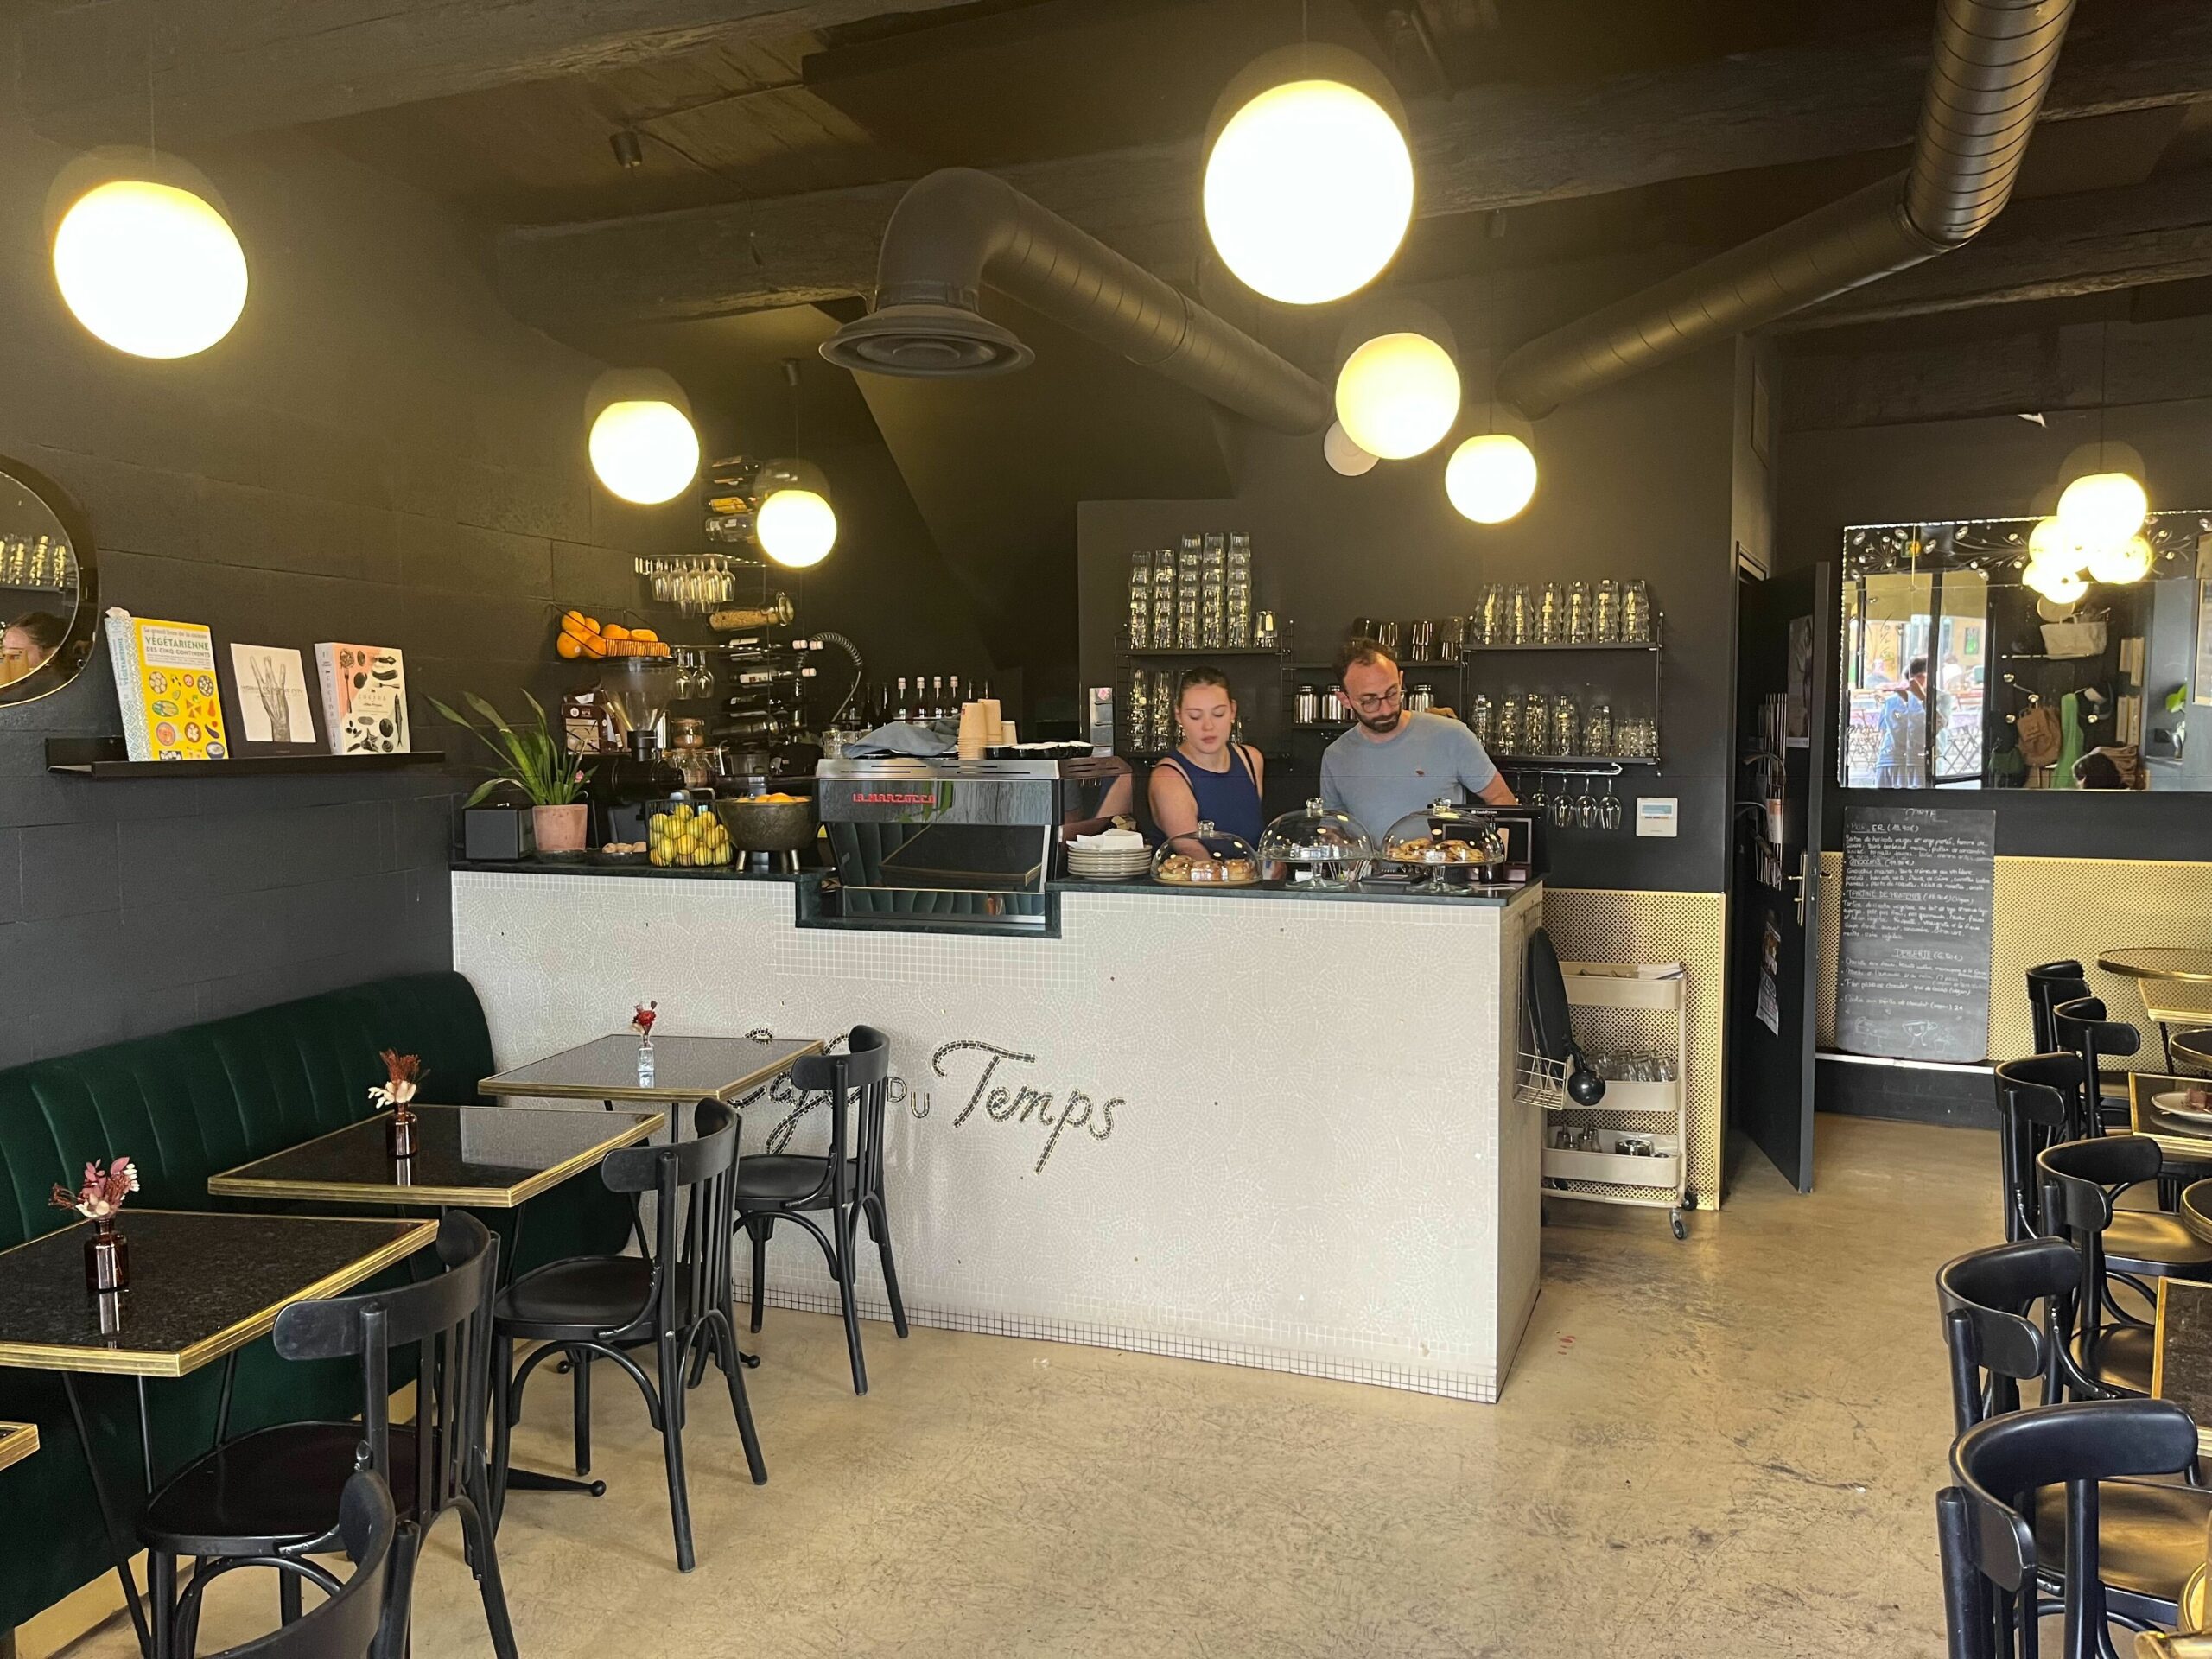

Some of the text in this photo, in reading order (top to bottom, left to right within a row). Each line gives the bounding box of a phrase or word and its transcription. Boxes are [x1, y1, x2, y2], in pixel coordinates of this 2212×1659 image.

[145, 636, 209, 650] VÉGÉTARIENNE
[887, 1076, 930, 1118] DU
[932, 1039, 1127, 1174] Temps
